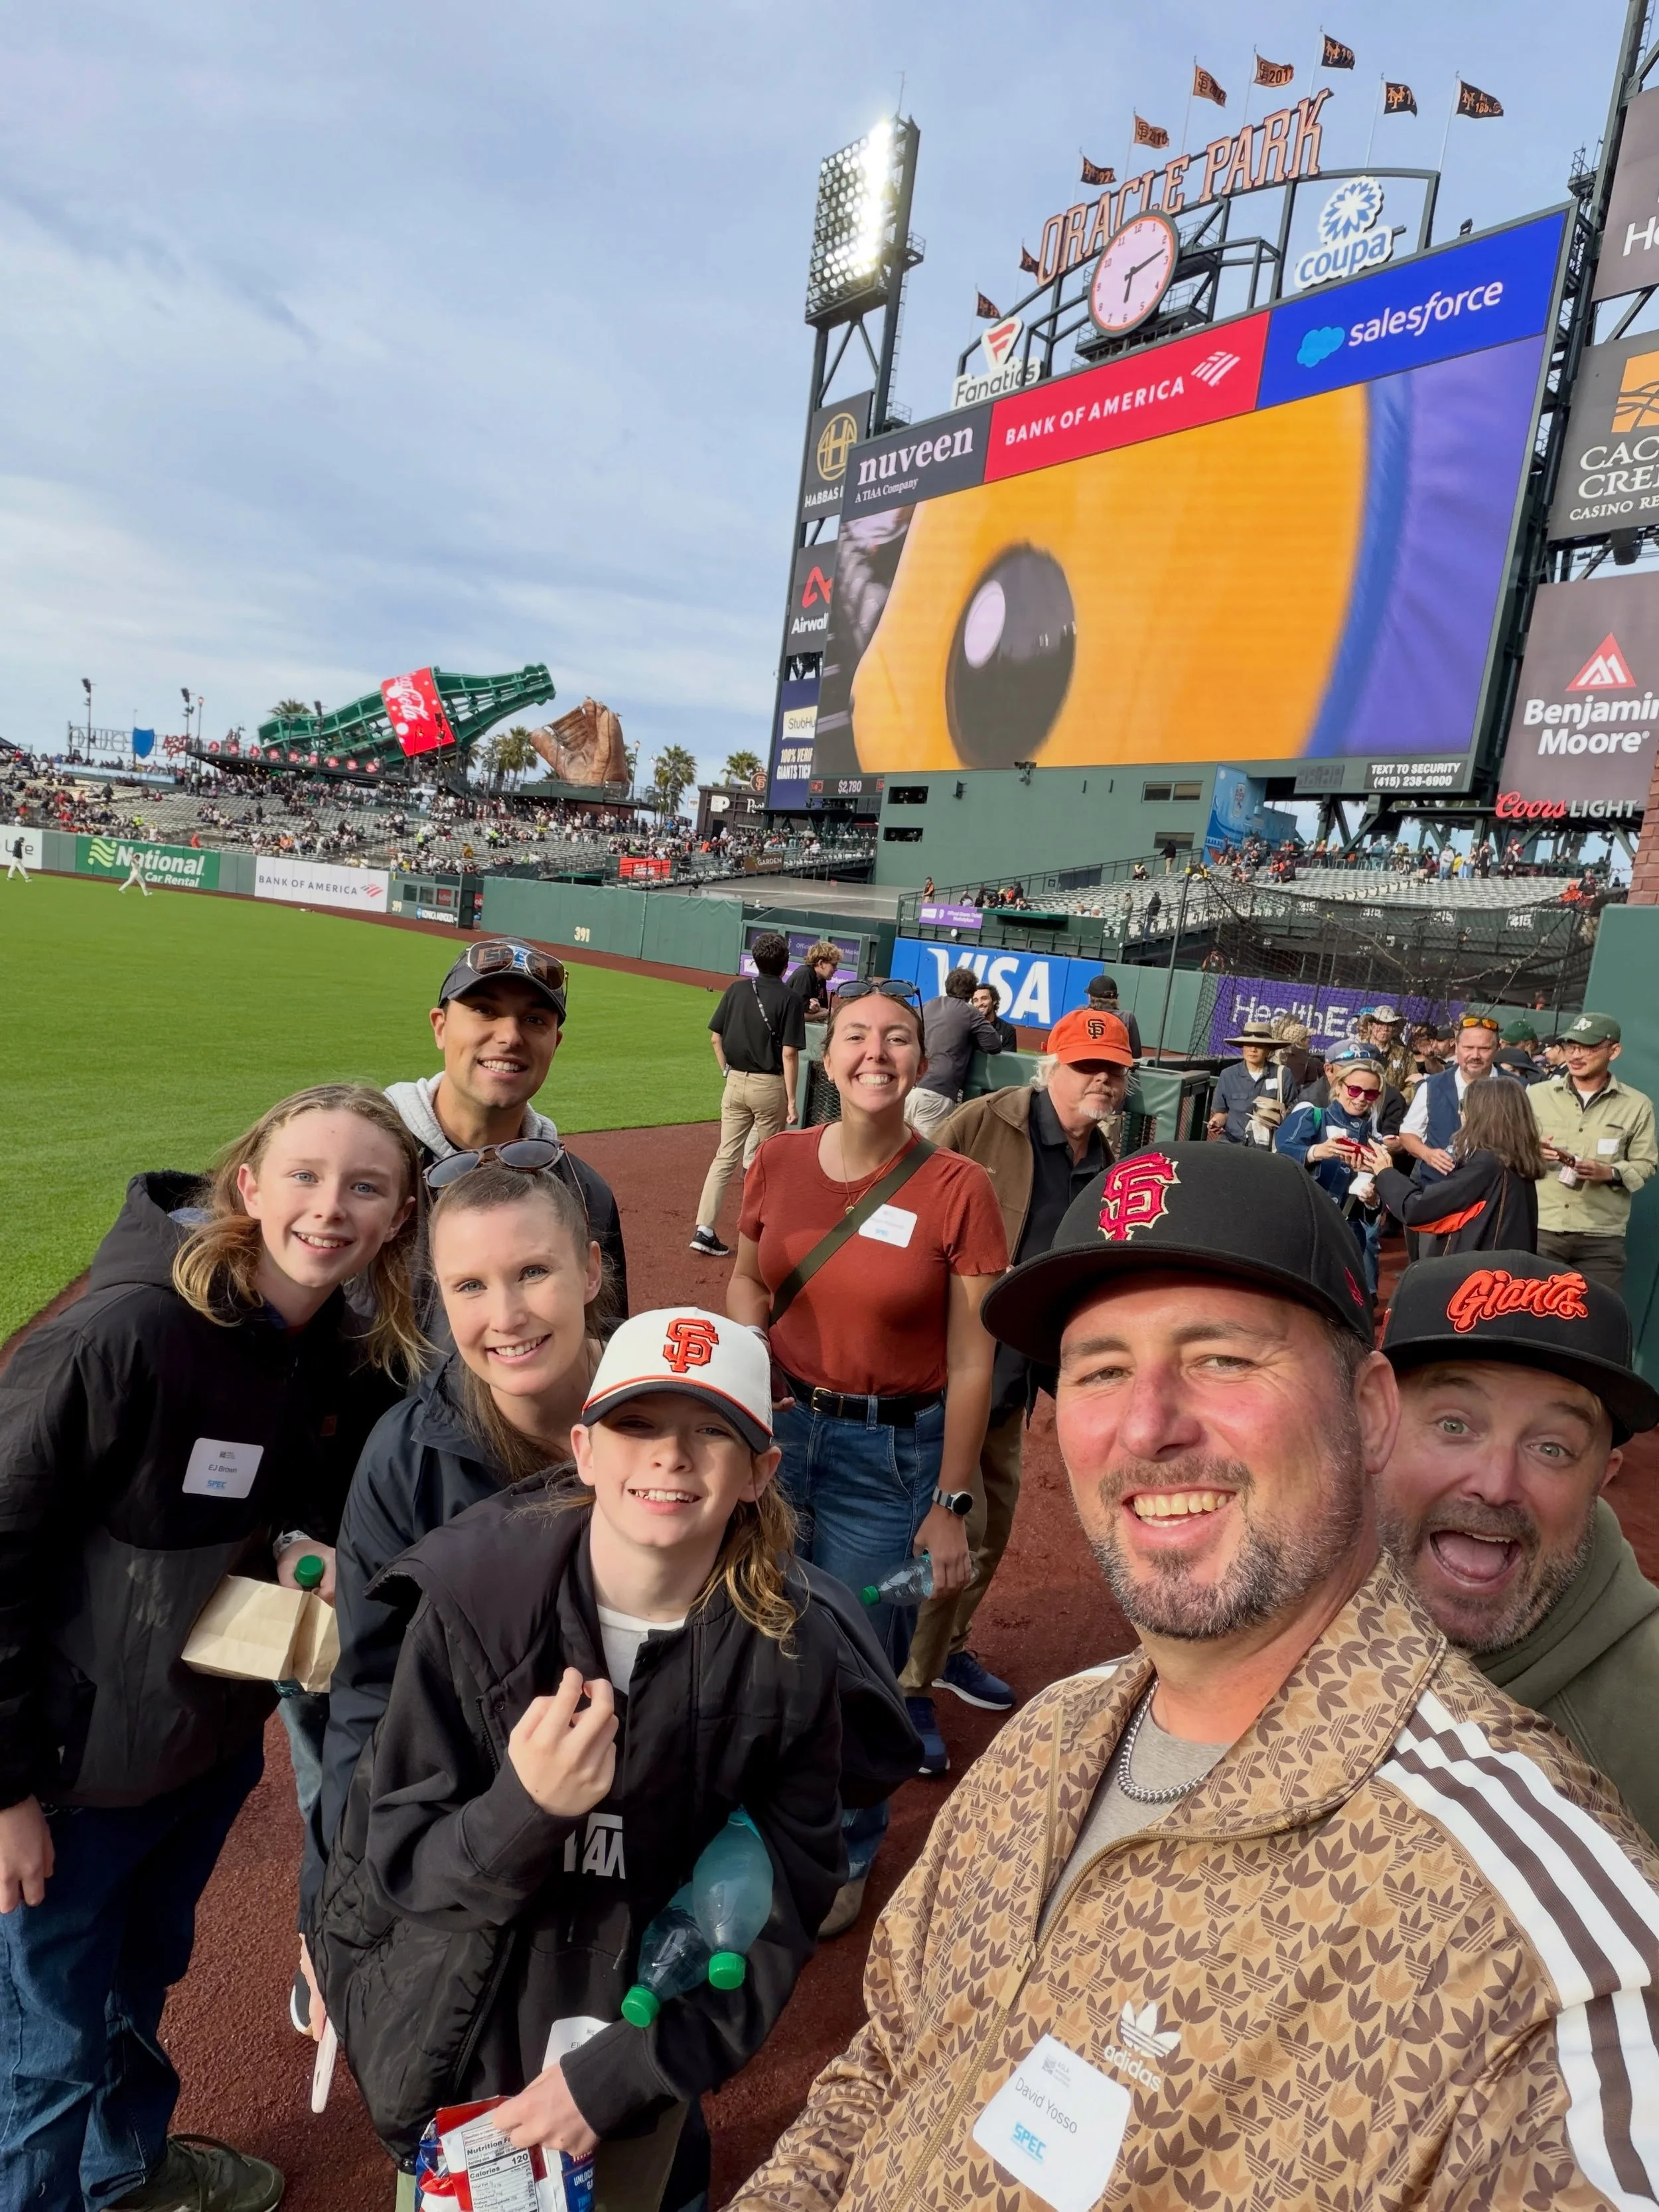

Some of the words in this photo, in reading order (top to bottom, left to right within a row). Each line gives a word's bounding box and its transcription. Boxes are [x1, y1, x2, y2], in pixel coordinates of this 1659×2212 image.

[1037, 155, 1191, 286] ORACLE
[1199, 88, 1330, 203] PARK
[1134, 223, 1143, 234] 12
[1151, 223, 1157, 232] 1
[1118, 236, 1126, 247] 11
[1161, 234, 1167, 245] 2
[1104, 258, 1113, 268] 10
[1163, 256, 1169, 265] 3
[1299, 232, 1388, 281] coupa
[1096, 282, 1102, 292] 9
[1154, 281, 1159, 290] 4
[1098, 302, 1104, 312] 8
[1139, 301, 1145, 311] 5
[1348, 281, 1503, 347] salesforce
[1108, 313, 1113, 323] 7
[1122, 313, 1128, 323] 6
[955, 360, 1035, 407] Fanatics
[1005, 415, 1054, 446] BANK
[1060, 406, 1084, 430] OF
[1088, 376, 1185, 421] AMERICA
[857, 427, 974, 486] nuveen
[804, 487, 839, 508] HABBAS
[855, 492, 862, 504] A
[862, 486, 882, 500] TIAA
[883, 479, 919, 496] Company
[1569, 500, 1634, 521] CASINO
[1538, 728, 1642, 755] Moore
[780, 749, 796, 763] 100%
[776, 765, 798, 780] GIANTS
[1371, 764, 1396, 775] TEXT
[1396, 764, 1408, 774] TO
[1410, 763, 1461, 775] SECURITY
[837, 780, 862, 794] $2,780
[1373, 776, 1401, 788] (415)
[1402, 775, 1453, 787] 238-6900
[1495, 790, 1567, 818] Coors
[1569, 799, 1639, 818] LIGHT
[757, 857, 782, 866] GARDEN
[145, 871, 163, 883] Car
[166, 873, 200, 887] Rental
[259, 875, 287, 887] BANK
[291, 879, 305, 888] OF
[308, 881, 358, 895] AMERICA
[573, 926, 591, 943] 391
[1087, 1019, 1106, 1039] SF
[1098, 1152, 1181, 1241] SF
[1447, 1270, 1589, 1333] Giants
[662, 1318, 719, 1374] SF
[1104, 2043, 1160, 2093] adidas
[1015, 2077, 1045, 2108] David
[1046, 2099, 1078, 2134] Yosso
[467, 2137, 502, 2156] Nutrition
[1012, 2121, 1047, 2160] SPEC
[469, 2166, 500, 2179] Calories
[511, 2153, 529, 2166] 120
